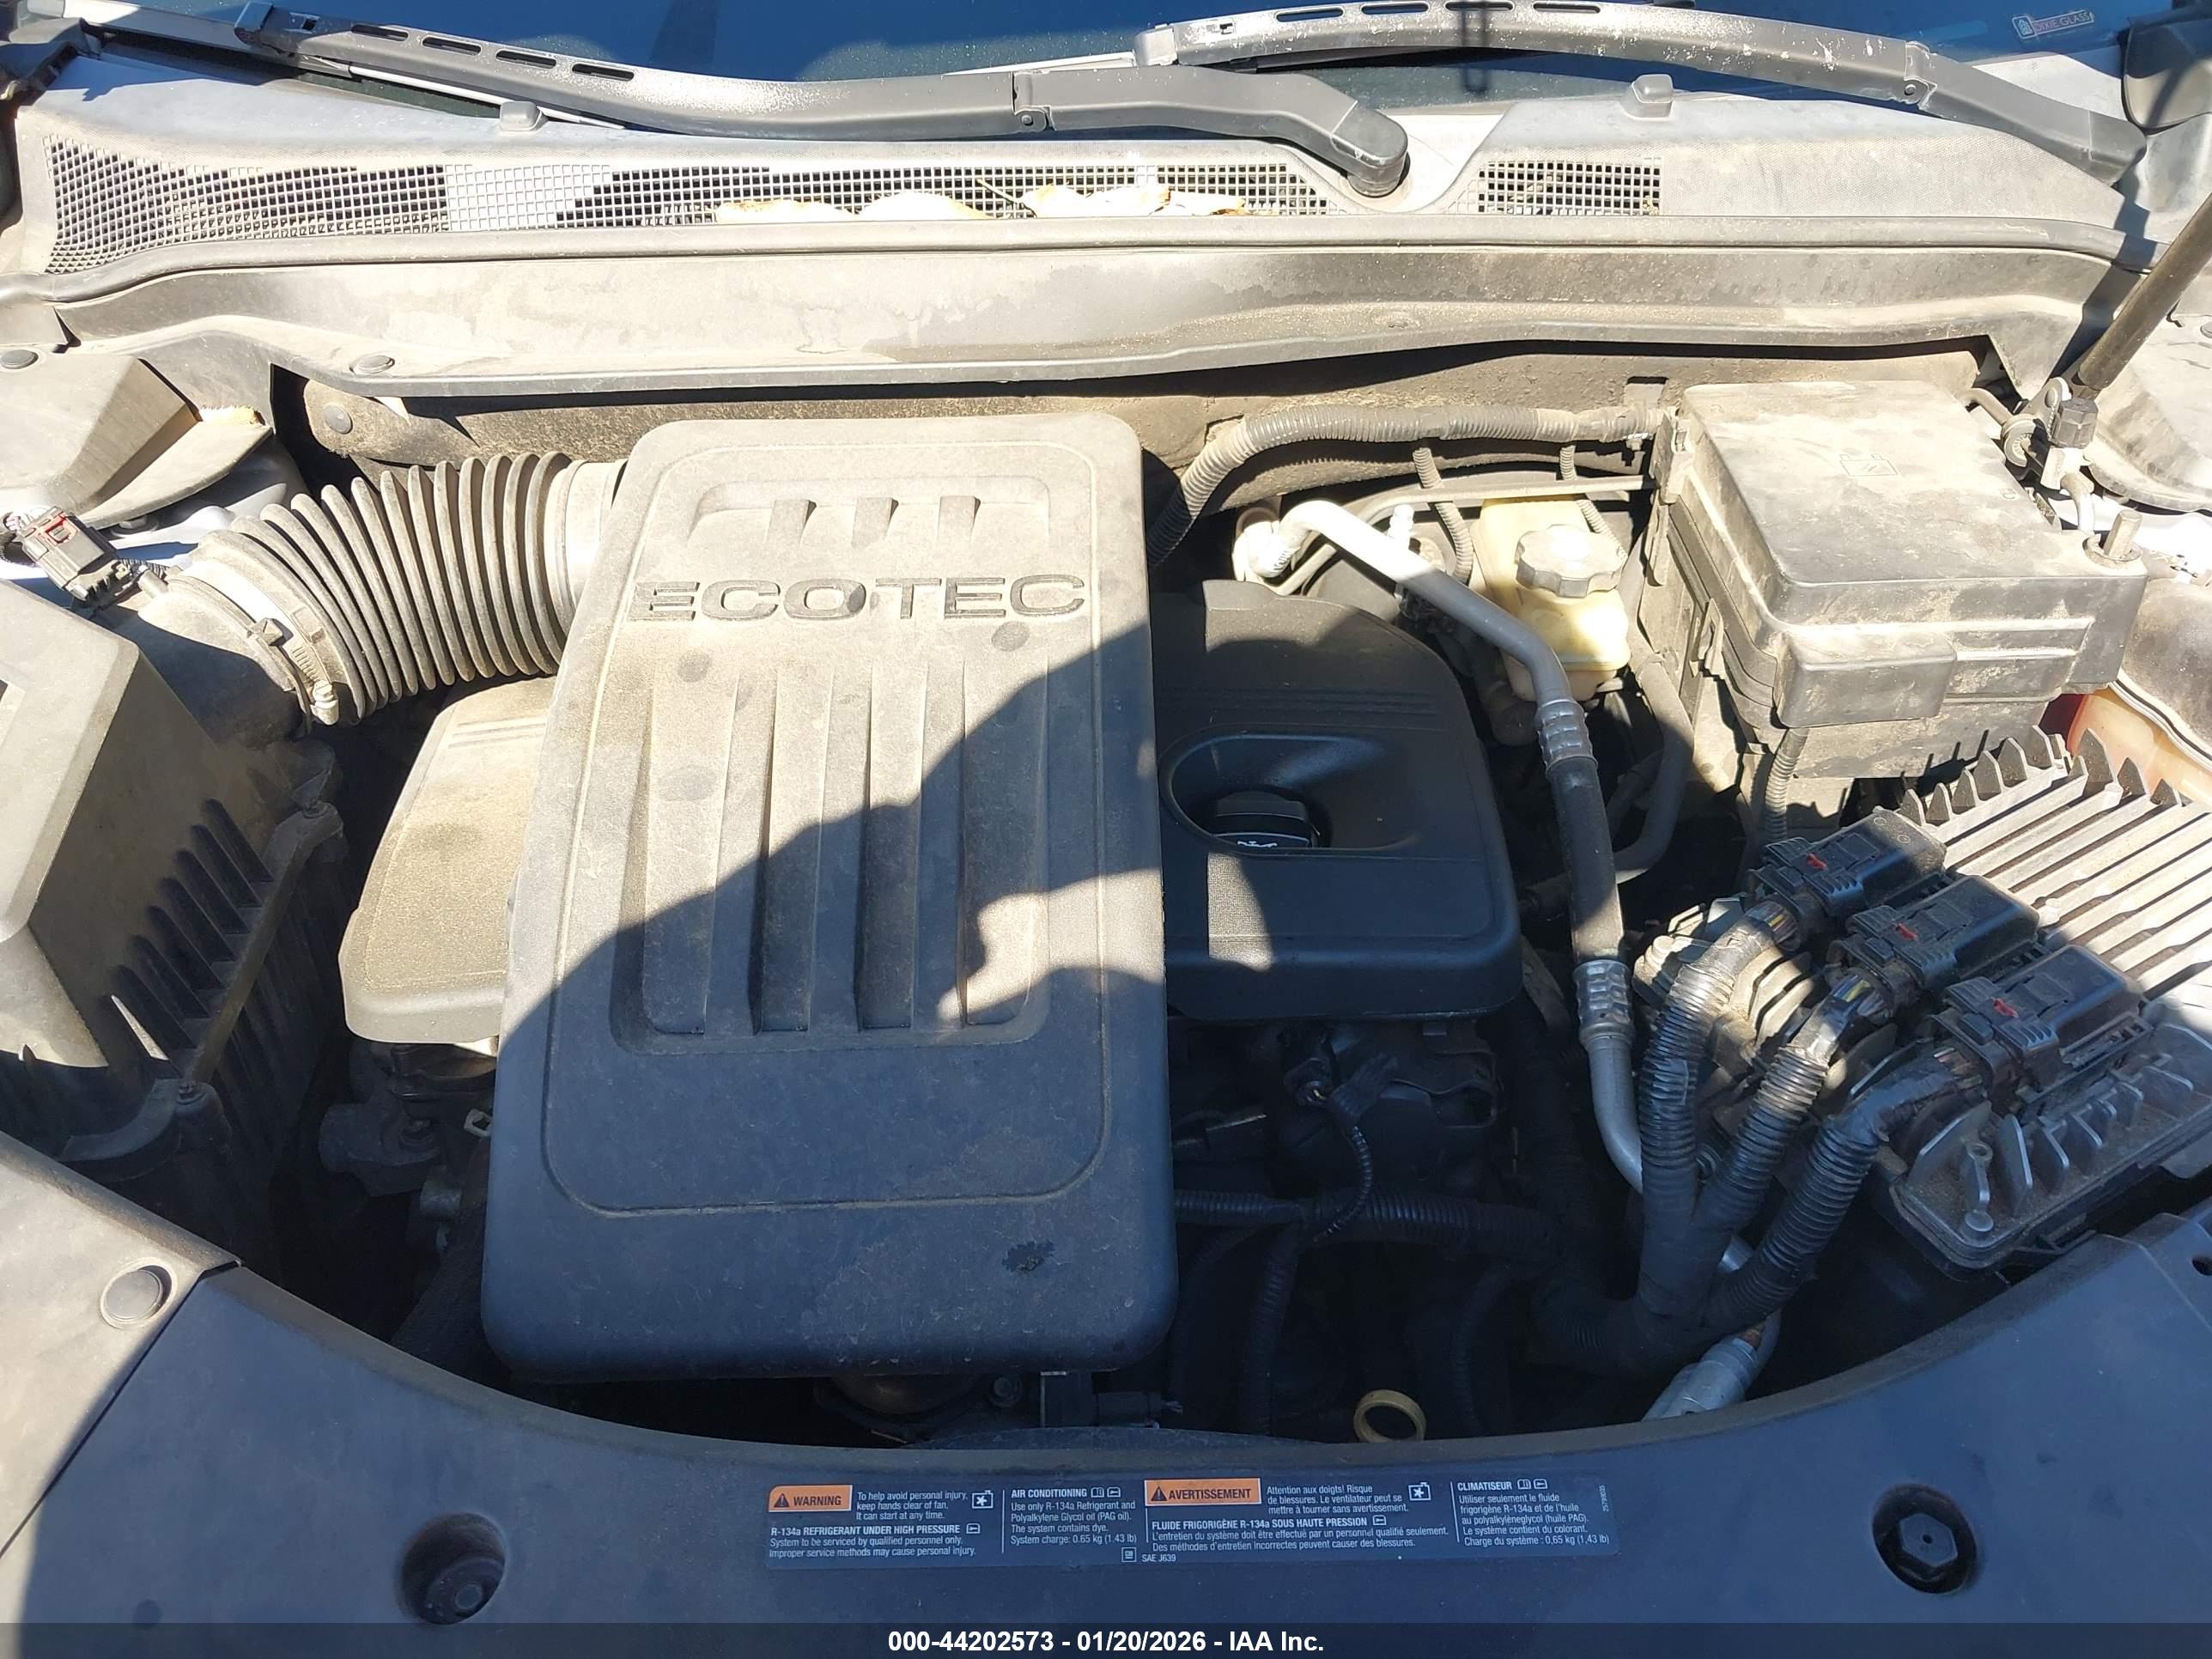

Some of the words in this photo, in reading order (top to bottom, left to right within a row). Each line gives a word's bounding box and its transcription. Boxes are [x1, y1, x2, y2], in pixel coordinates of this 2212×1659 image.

[2060, 12, 2090, 27] GLASS
[629, 574, 1085, 622] ECOTEC
[1267, 1486, 1302, 1495] Attention
[1318, 1485, 1345, 1495] doigts!
[1346, 1484, 1373, 1494] Risque
[1457, 1481, 1513, 1491] CLIMATISEUR
[858, 1492, 866, 1501] To
[868, 1492, 885, 1502] help
[886, 1491, 908, 1500] avoid
[909, 1490, 943, 1500] personal
[945, 1490, 969, 1501] injury.
[1011, 1489, 1026, 1498] AIR
[1028, 1488, 1087, 1498] CONDITIONING
[1169, 1488, 1252, 1500] AVERTISSEMENT
[1267, 1496, 1278, 1504] de
[1279, 1495, 1319, 1504] blessures.
[1320, 1495, 1330, 1504] Le
[1331, 1494, 1373, 1504] ventilateur
[1374, 1494, 1392, 1504] peut
[1459, 1494, 1486, 1504] Utiliser
[1487, 1494, 1528, 1503] seulement
[1529, 1493, 1537, 1502] le
[1538, 1492, 1560, 1502] fluide
[793, 1496, 842, 1506] WARNING
[857, 1501, 876, 1511] keep
[878, 1500, 902, 1510] hands
[902, 1500, 922, 1510] clear
[923, 1500, 933, 1510] of
[933, 1500, 949, 1510] fan.
[1011, 1503, 1026, 1511] Use
[1027, 1502, 1044, 1513] only
[1045, 1502, 1074, 1510] R-134a
[1076, 1500, 1120, 1512] Refrigerant
[1121, 1500, 1136, 1510] and
[1268, 1505, 1294, 1515] mettre
[1295, 1504, 1301, 1514] à
[1303, 1505, 1330, 1514] tourner
[1352, 1504, 1409, 1513] avertissement.
[1460, 1504, 1502, 1516] frigorigène
[1504, 1504, 1533, 1513] R-134a
[1534, 1504, 1542, 1513] et
[1544, 1504, 1554, 1512] de
[1556, 1503, 1579, 1511] l'huile
[856, 1511, 863, 1520] It
[863, 1512, 878, 1521] can
[879, 1511, 898, 1520] start
[899, 1511, 908, 1520] at
[908, 1512, 924, 1522] any
[926, 1510, 945, 1520] time.
[1011, 1513, 1060, 1523] Polyalkylene
[1060, 1512, 1085, 1522] Glycol
[1085, 1512, 1096, 1521] oil
[1097, 1511, 1116, 1522] (PAG
[1117, 1511, 1132, 1521] oil).
[1545, 1514, 1566, 1524] (huile
[1568, 1513, 1589, 1523] PAG).
[1012, 1524, 1026, 1533] The
[1027, 1525, 1055, 1534] system
[1057, 1523, 1091, 1532] contains
[1091, 1523, 1109, 1534] dye.
[1152, 1521, 1182, 1530] FLUIDE
[1182, 1517, 1238, 1529] FRIGORIGÈNE
[1240, 1520, 1270, 1528] R-134a
[1272, 1518, 1295, 1528] SOUS
[1296, 1518, 1324, 1528] HAUTE
[1325, 1517, 1368, 1527] PRESSION
[770, 1527, 801, 1536] R-134a
[803, 1526, 861, 1535] REFRIGERANT
[863, 1525, 892, 1534] UNDER
[893, 1525, 915, 1534] HIGH
[915, 1524, 961, 1534] PRESSURE
[1152, 1531, 1193, 1541] L'entretien
[1194, 1531, 1205, 1540] du
[1206, 1531, 1239, 1542] système
[1241, 1530, 1256, 1540] doit
[1258, 1530, 1273, 1539] être
[1275, 1528, 1307, 1539] effectué
[1309, 1530, 1322, 1540] par
[1376, 1527, 1404, 1538] qualifié
[1406, 1527, 1449, 1536] seulement.
[1462, 1527, 1473, 1535] Le
[1474, 1525, 1508, 1536] système
[1509, 1525, 1540, 1534] contient
[1541, 1525, 1553, 1534] du
[1553, 1524, 1588, 1534] colorant.
[769, 1538, 799, 1548] System
[801, 1538, 810, 1547] to
[811, 1538, 822, 1547] be
[823, 1537, 856, 1547] serviced
[858, 1537, 869, 1547] by
[869, 1536, 902, 1547] qualified
[904, 1535, 944, 1547] personnel
[945, 1535, 963, 1547] only.
[1010, 1535, 1040, 1546] System
[1041, 1534, 1071, 1546] charge:
[1073, 1534, 1091, 1543] 0.65
[1092, 1534, 1103, 1545] kg
[1104, 1534, 1125, 1545] (1.43
[1127, 1533, 1138, 1544] lb)
[1152, 1542, 1168, 1552] Des
[1170, 1542, 1208, 1552] méthodes
[1210, 1540, 1252, 1552] d'entretien
[1254, 1540, 1297, 1550] incorrectes
[1298, 1540, 1330, 1550] peuvent
[1332, 1540, 1358, 1548] causer
[1359, 1539, 1375, 1547] des
[1376, 1538, 1416, 1547] blessures.
[1464, 1537, 1492, 1547] Charge
[1494, 1536, 1505, 1545] du
[1506, 1535, 1540, 1547] système
[1545, 1535, 1563, 1545] 0,65
[1565, 1534, 1576, 1546] kg
[1599, 1534, 1610, 1545] lb)
[769, 1548, 805, 1559] Improper
[806, 1548, 835, 1558] service
[836, 1547, 872, 1557] methods
[872, 1548, 890, 1558] may
[916, 1547, 951, 1557] personal
[952, 1547, 976, 1557] injury.
[1141, 1553, 1157, 1563] SAE
[1158, 1553, 1176, 1563] J639
